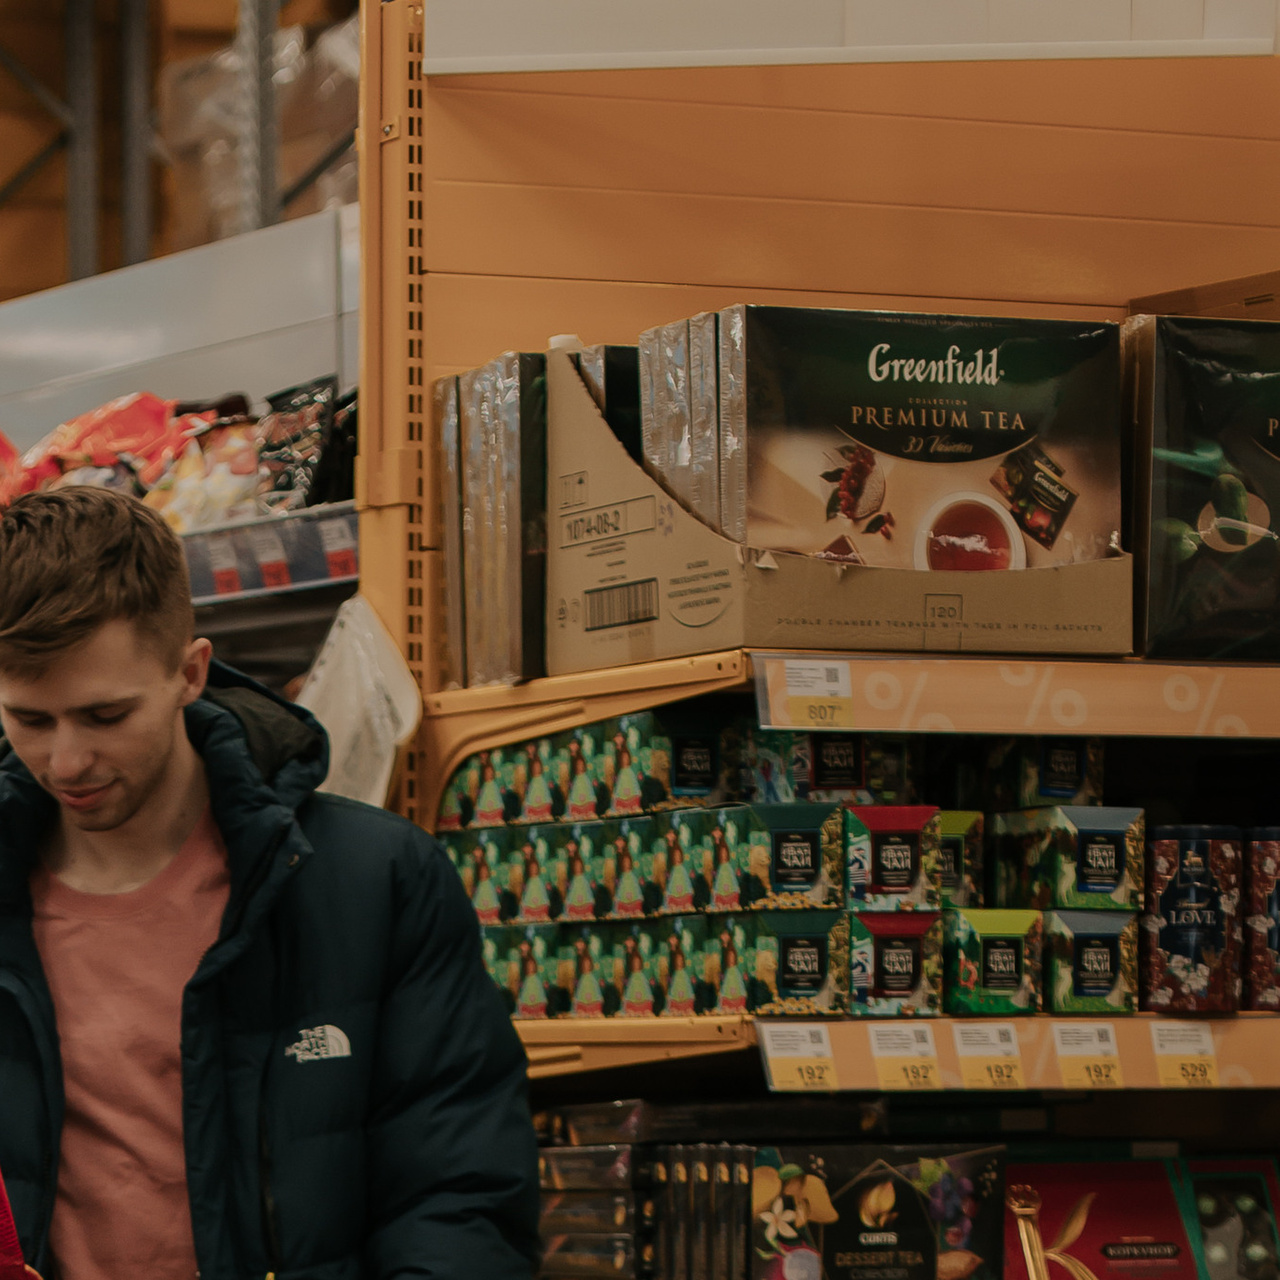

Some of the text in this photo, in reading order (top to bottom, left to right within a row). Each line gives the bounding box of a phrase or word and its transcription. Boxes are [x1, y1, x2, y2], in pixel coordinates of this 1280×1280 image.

[869, 343, 1000, 385] Greenfield
[851, 406, 1025, 431] PREMIUM TEA
[930, 607, 956, 618] 120
[835, 1250, 925, 1267] DESSERT TEA
